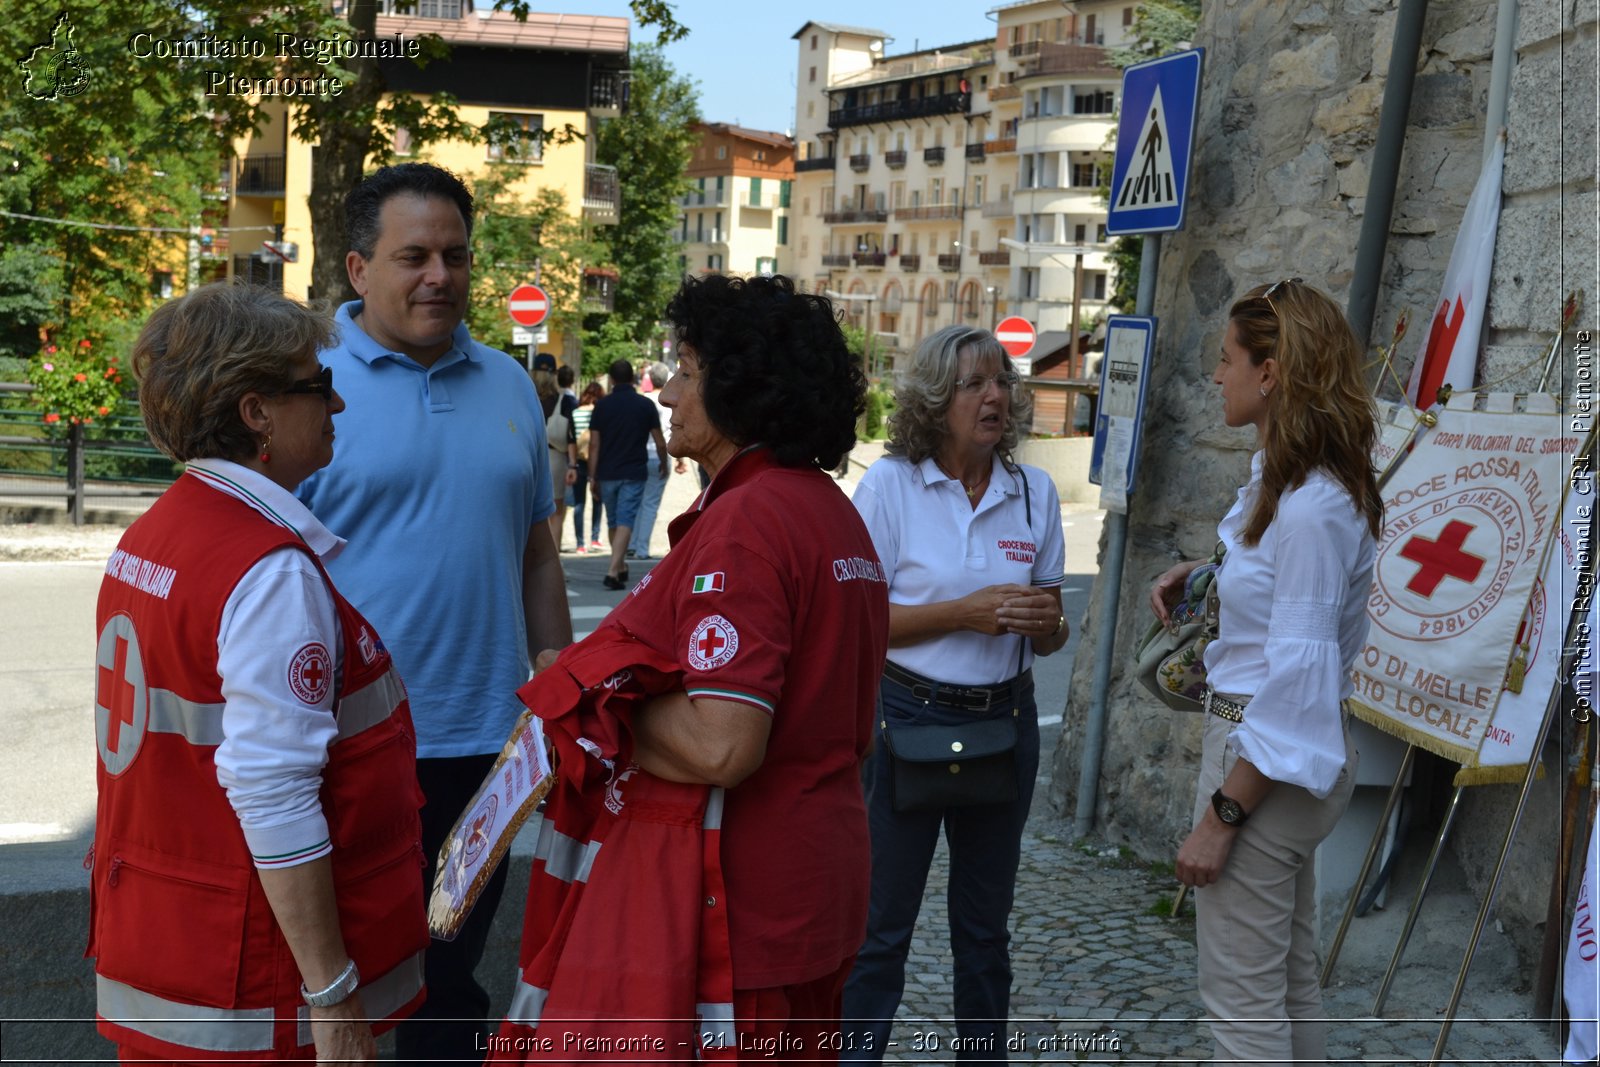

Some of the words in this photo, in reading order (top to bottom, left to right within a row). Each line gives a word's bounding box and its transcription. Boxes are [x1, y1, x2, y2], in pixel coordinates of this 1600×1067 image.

[1433, 432, 1464, 450] CORPO
[1465, 433, 1513, 451] VOLONTARI
[1515, 437, 1537, 454] DEL
[1383, 474, 1447, 514] ROCE
[1453, 457, 1522, 485] ROSSA
[1519, 468, 1548, 565] ITALIANA
[1432, 499, 1450, 515] DI
[1457, 491, 1517, 530] GINEVRA
[1505, 531, 1521, 554] 22
[1467, 559, 1515, 621] AGOSTO
[1418, 614, 1466, 635] 1864
[1384, 655, 1408, 681] DI
[1411, 668, 1493, 711] MELLE
[1394, 689, 1480, 740] LOCALE
